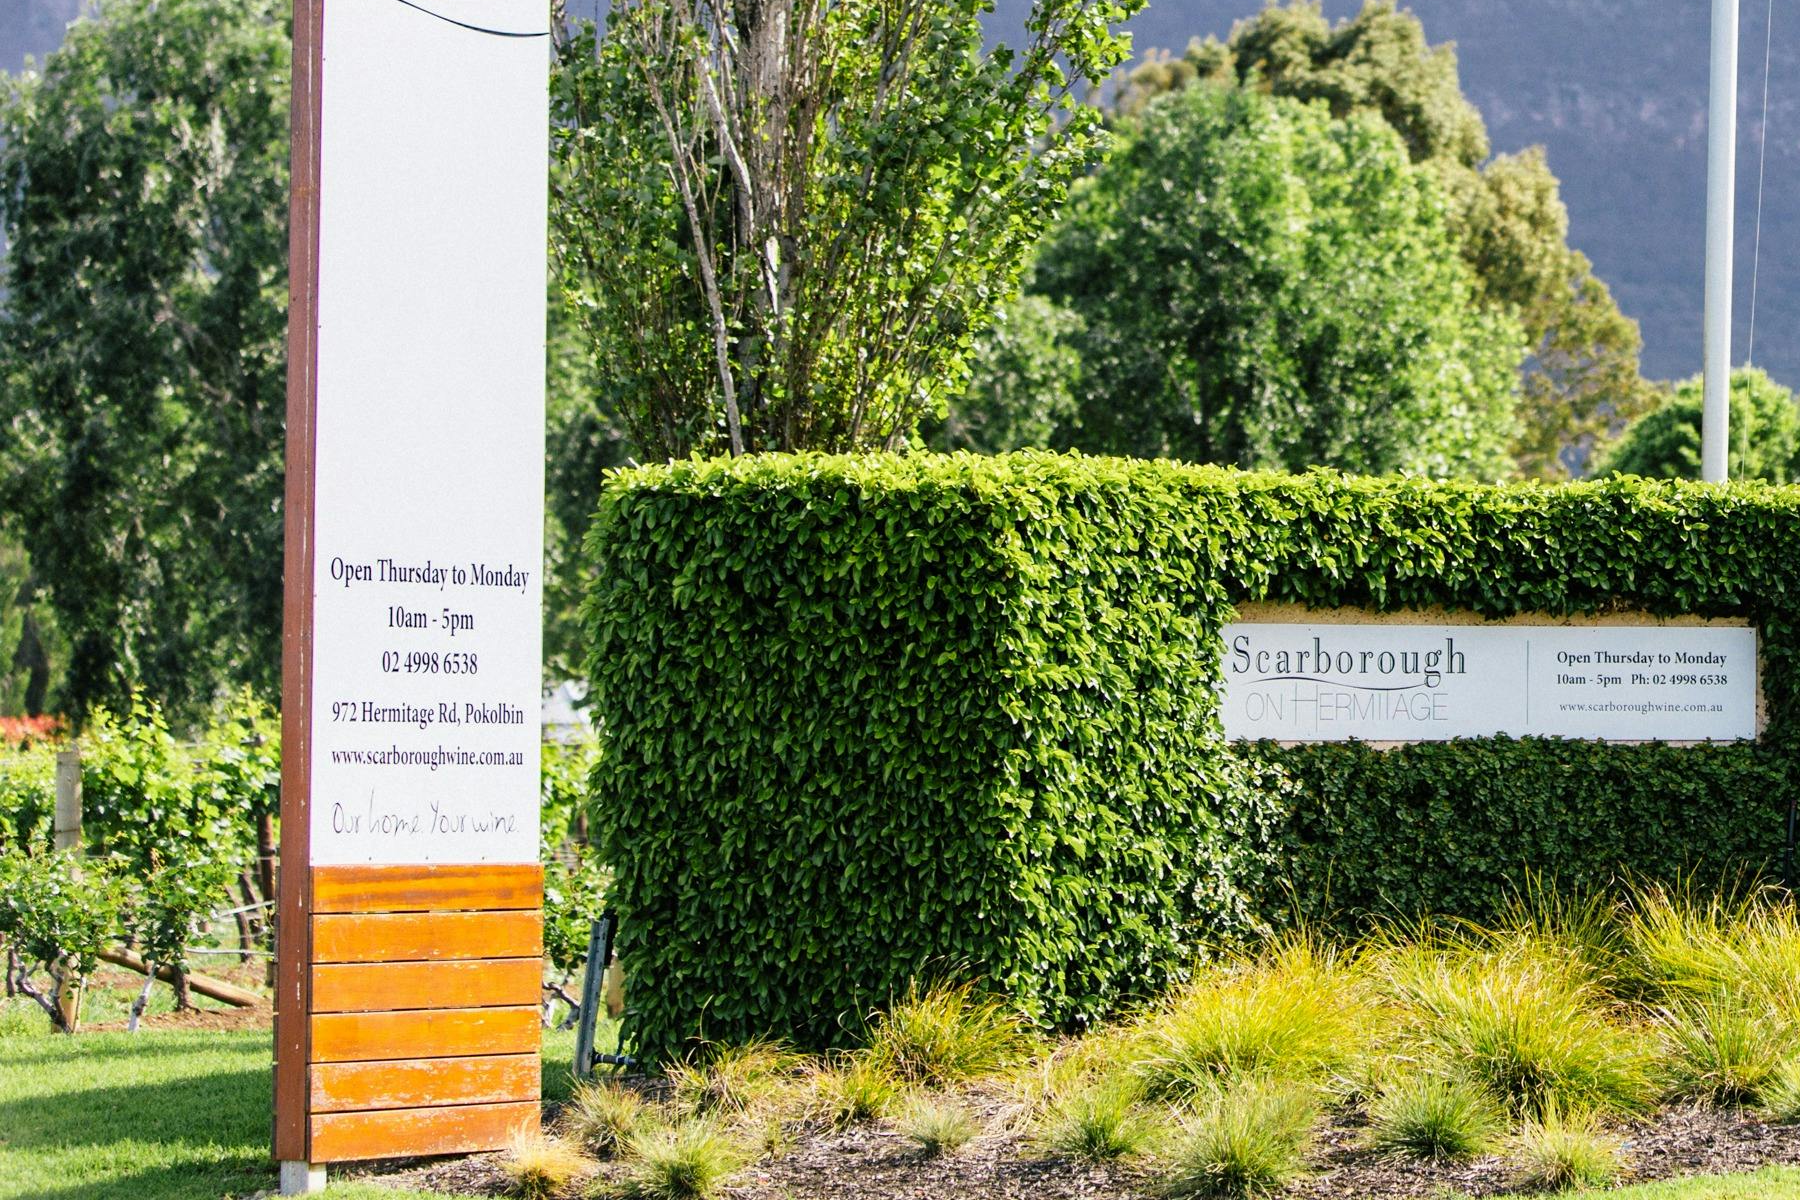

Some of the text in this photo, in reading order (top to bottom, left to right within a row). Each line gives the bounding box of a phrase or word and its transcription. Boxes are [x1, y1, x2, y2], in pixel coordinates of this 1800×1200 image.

[331, 556, 529, 594] Open Thursday to Monday
[388, 606, 428, 629] 10am
[441, 608, 475, 636] 5pm
[382, 651, 479, 675] 02 4998 6538
[1231, 635, 1467, 688] Scarborough
[1556, 651, 1727, 668] Open Thursday to Monday
[1556, 673, 1586, 685] 10am
[1596, 674, 1622, 688] 5pm
[1631, 673, 1650, 685] Ph:
[1652, 674, 1667, 685] 02
[1669, 674, 1697, 685] 4998
[1699, 674, 1728, 685] 6538
[332, 701, 524, 729] 972 Hermitage Rd, Pokolbin
[1245, 682, 1449, 733] ON HERMITAGE
[1559, 701, 1723, 715] www.scarboroughwine.com.au
[331, 745, 524, 771] www.scarboroughwine.com.au
[333, 802, 363, 834] Our
[429, 799, 467, 835] Your
